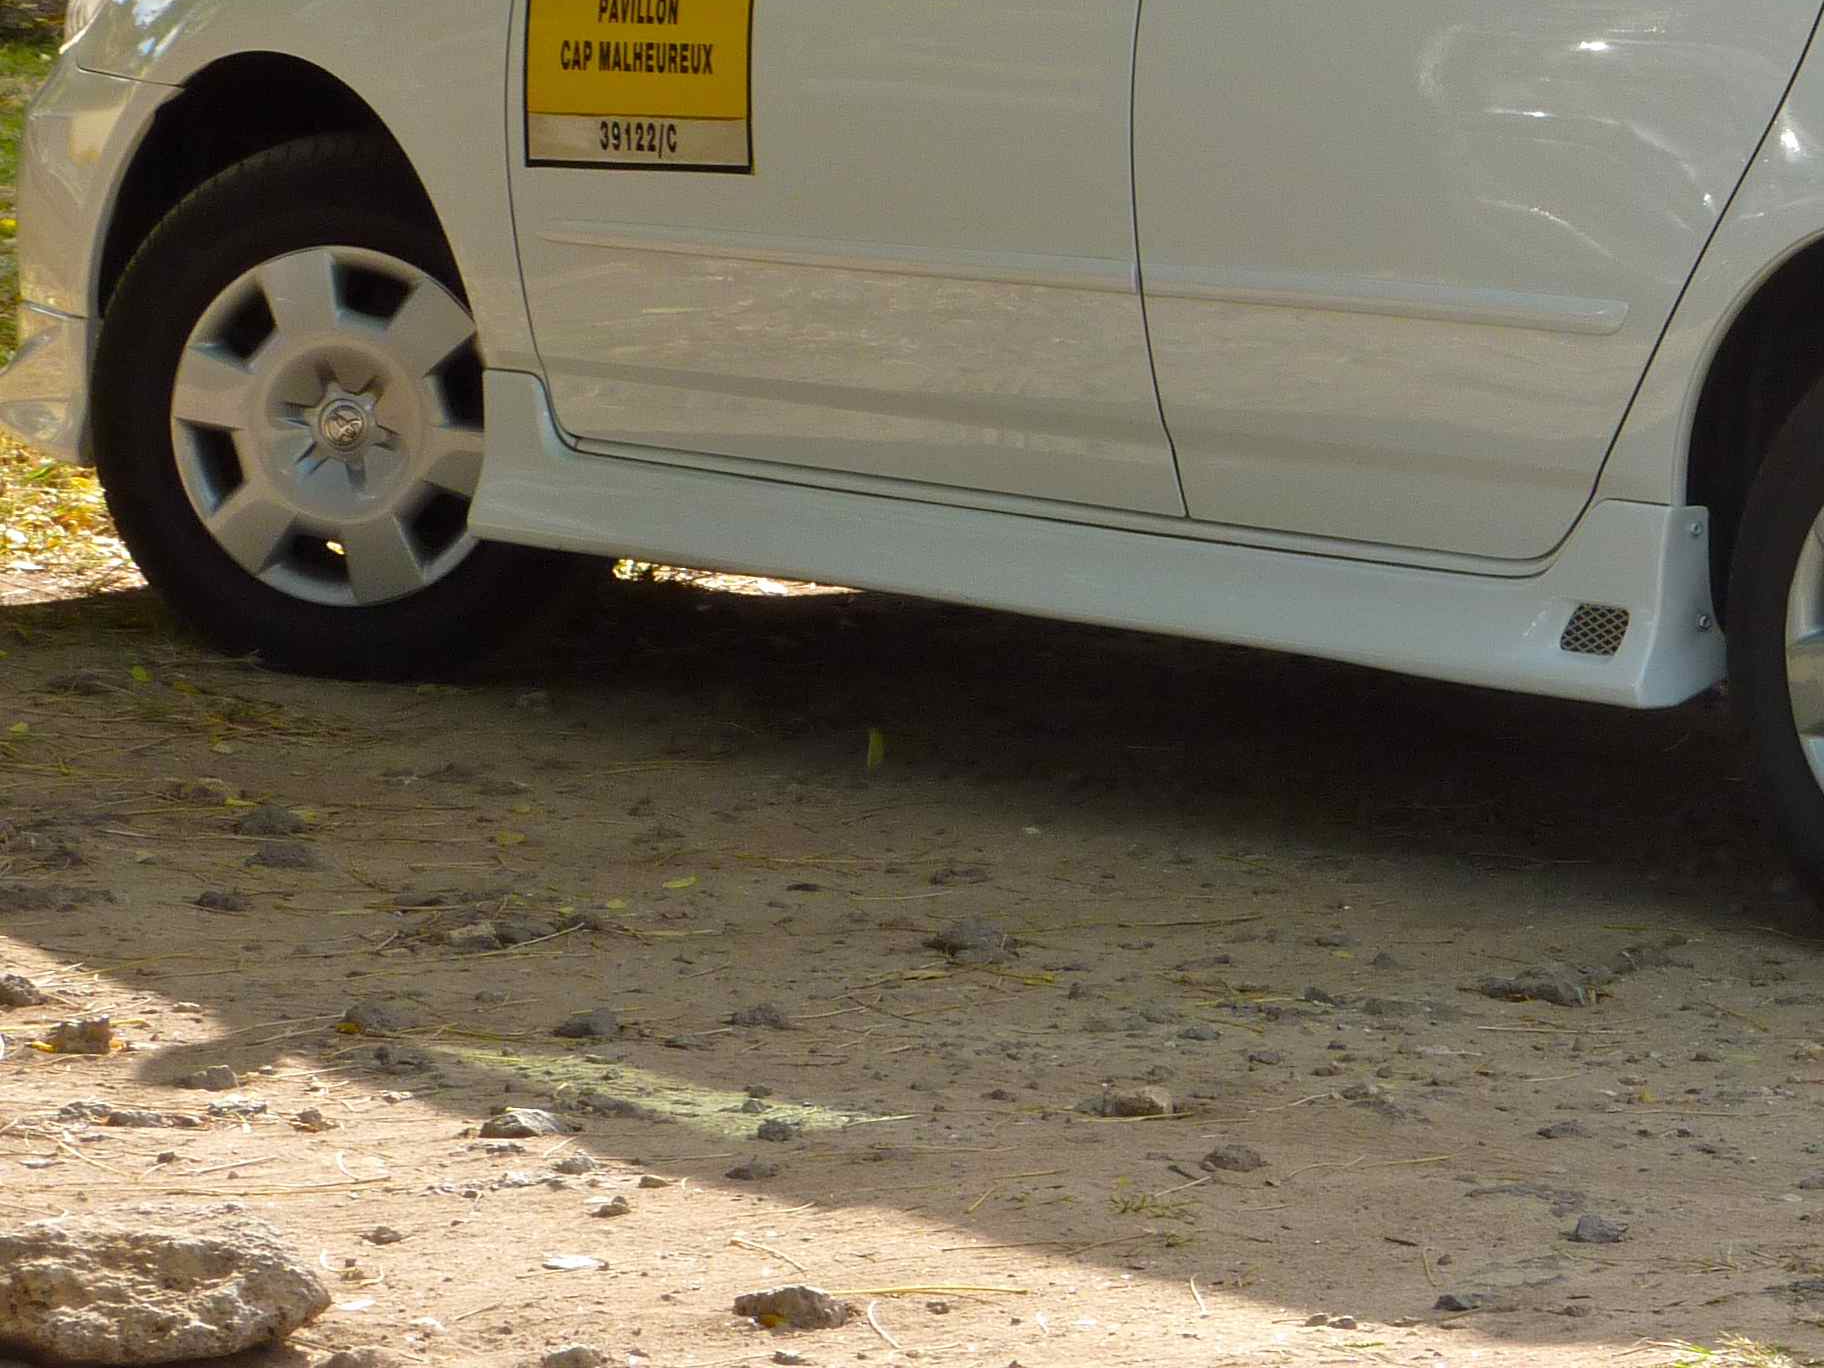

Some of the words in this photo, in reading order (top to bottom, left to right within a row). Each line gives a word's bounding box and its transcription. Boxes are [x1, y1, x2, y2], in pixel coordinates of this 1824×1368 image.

[561, 40, 592, 71] CAP
[599, 42, 713, 74] MALHEUREUX
[600, 121, 677, 158] 39122/C
